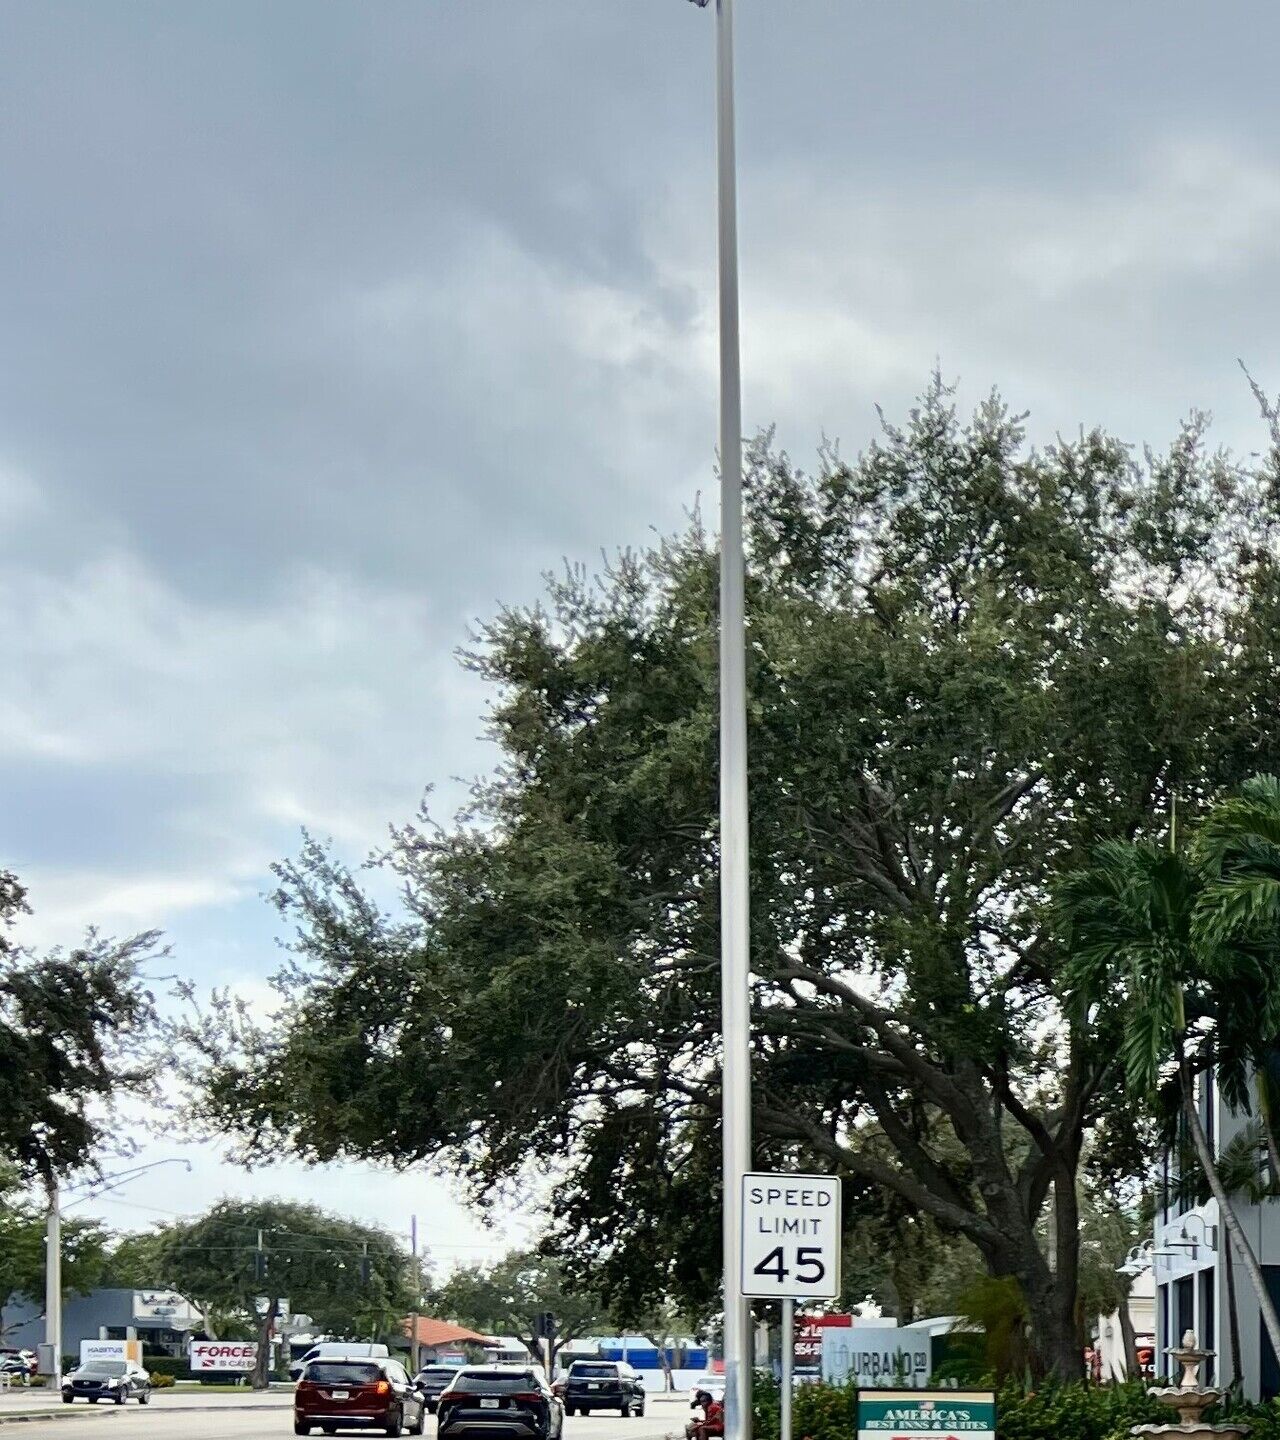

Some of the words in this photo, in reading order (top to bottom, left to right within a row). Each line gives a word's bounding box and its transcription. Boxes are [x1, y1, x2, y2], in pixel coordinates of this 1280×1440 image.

[751, 1188, 831, 1207] SPEED
[760, 1217, 821, 1234] LIMIT
[753, 1246, 826, 1284] 45
[194, 1346, 255, 1357] FORCE
[219, 1360, 256, 1368] SCUB
[883, 1409, 971, 1421] AMERICA'S
[865, 1420, 896, 1429] BEST
[899, 1420, 930, 1429] INNS
[932, 1420, 942, 1429] &
[944, 1421, 988, 1430] SUITES
